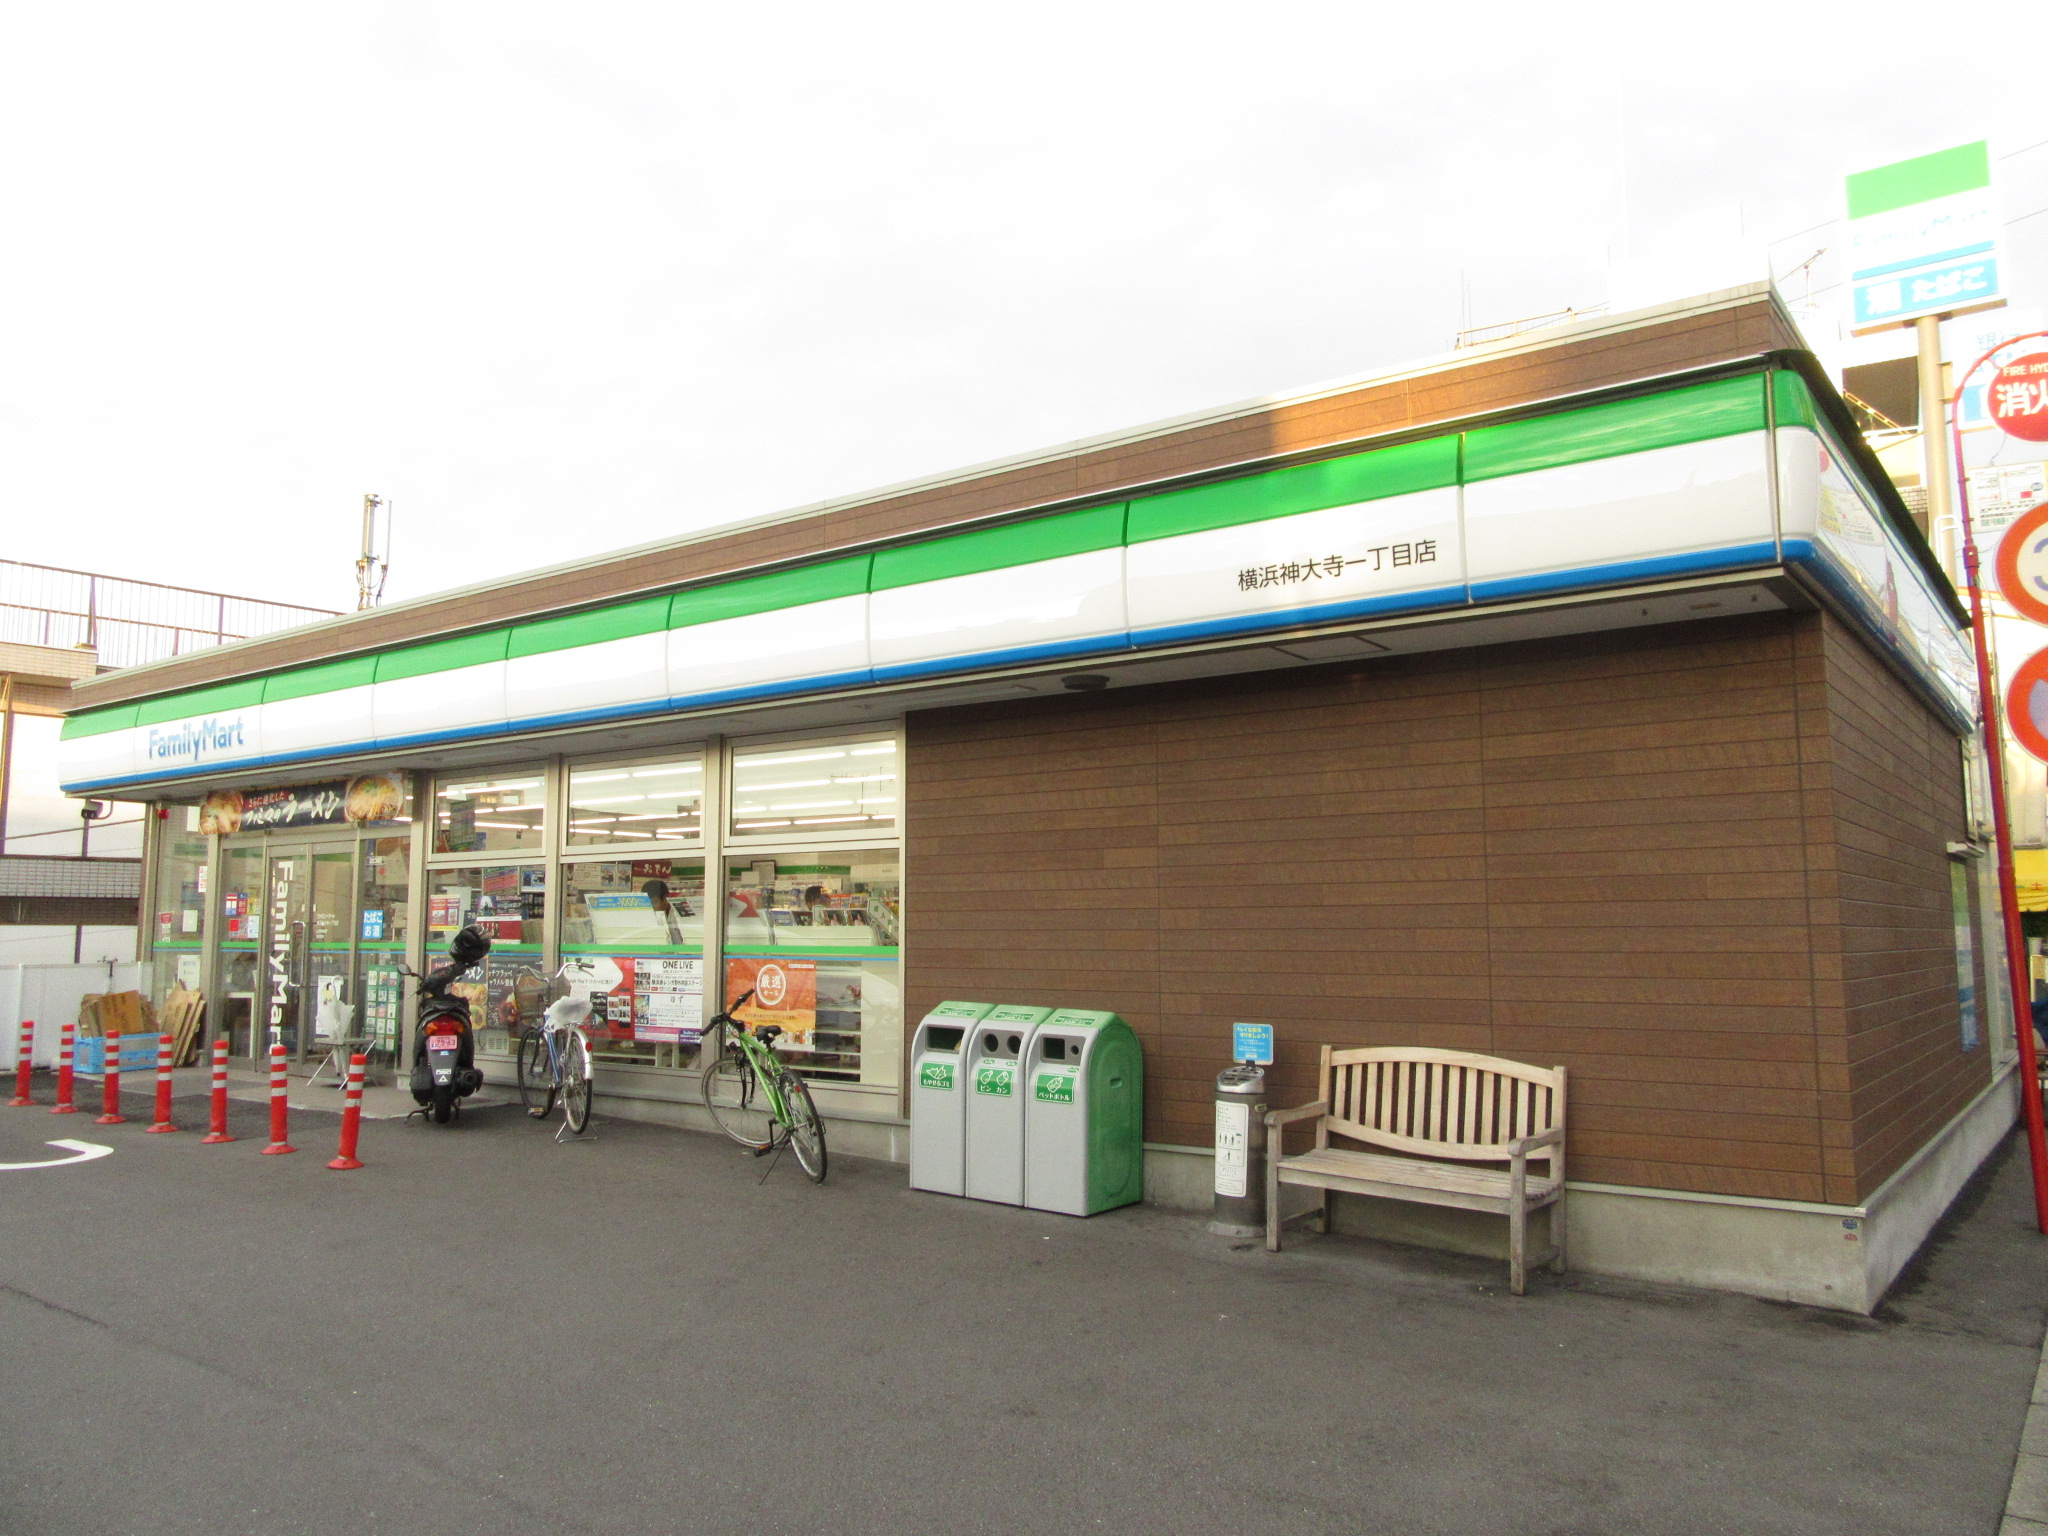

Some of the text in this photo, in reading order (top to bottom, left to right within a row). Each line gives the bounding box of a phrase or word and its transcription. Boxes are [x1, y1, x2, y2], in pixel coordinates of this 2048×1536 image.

[1911, 265, 1988, 303] たばこ
[2003, 365, 2027, 377] FIRE
[1238, 540, 1437, 592] 横浜神大寺一丁目店
[148, 716, 244, 762] FamilyMart
[363, 911, 383, 924] たばこ
[662, 960, 694, 970] ONE LIVE
[760, 974, 782, 989] 厳選
[922, 1078, 950, 1088] もやせるゴミ
[979, 1085, 1008, 1094] ビン カン
[1038, 1092, 1071, 1101] ペットボトル
